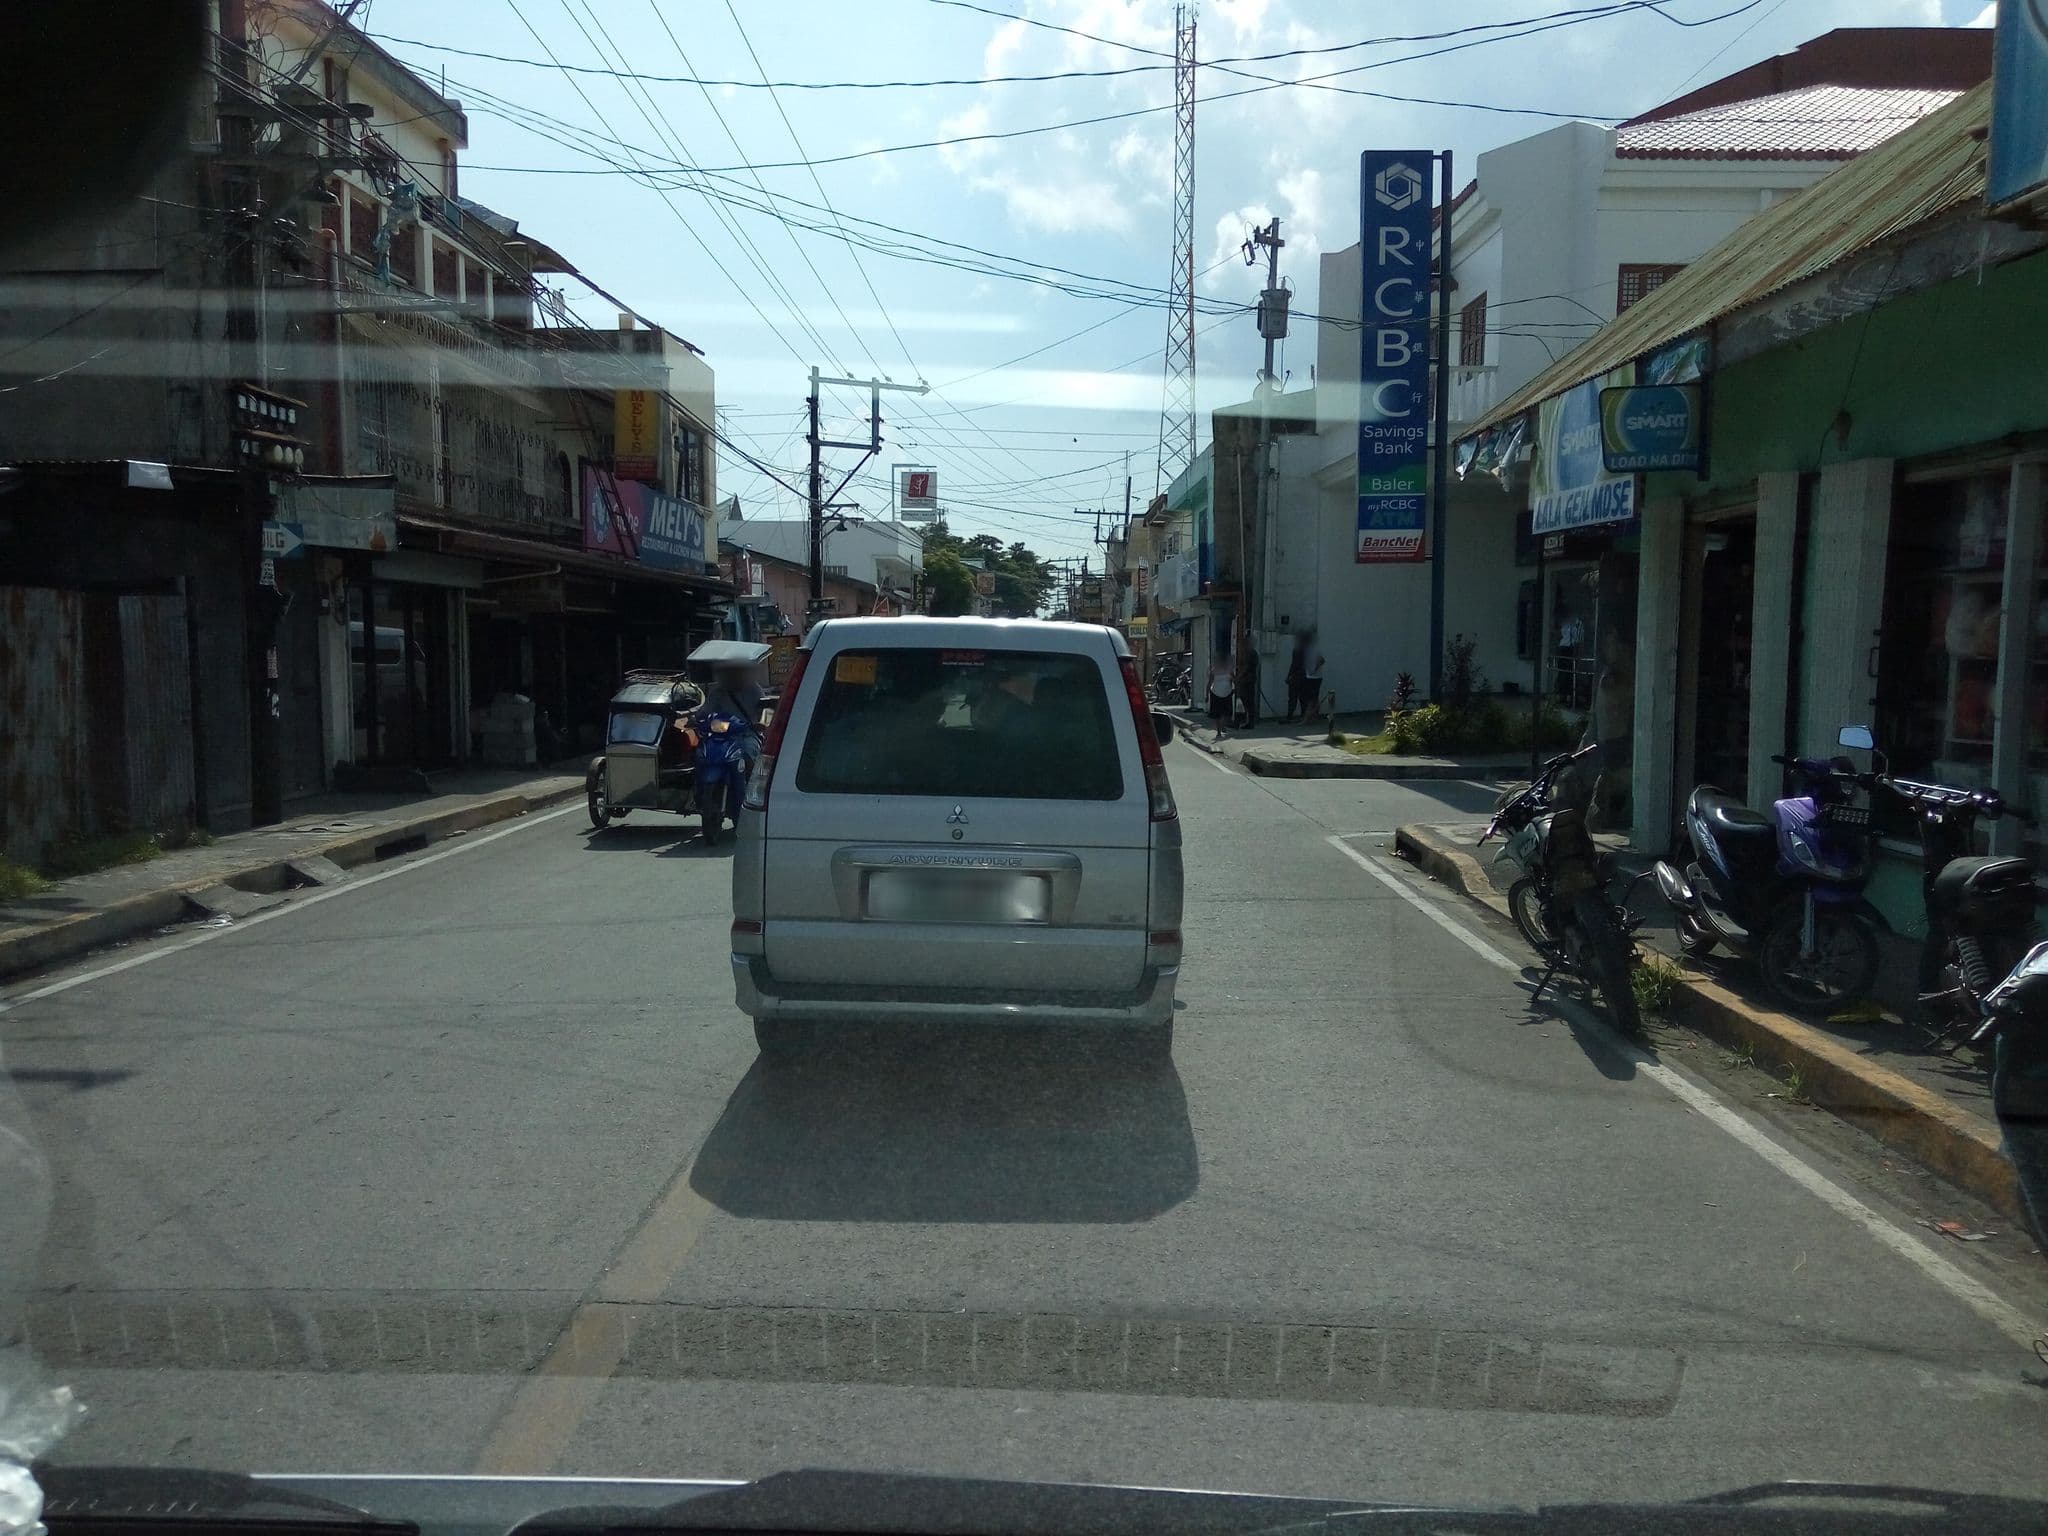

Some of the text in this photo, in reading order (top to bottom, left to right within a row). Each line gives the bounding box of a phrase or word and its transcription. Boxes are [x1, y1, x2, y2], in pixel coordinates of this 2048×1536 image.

[1373, 226, 1415, 418] RCBC
[1626, 412, 1688, 431] SMART
[1364, 425, 1424, 441] Savings
[1374, 442, 1413, 455] Bank
[1611, 455, 1647, 468] LOAD
[1650, 454, 1668, 465] NA
[1372, 478, 1415, 491] Baler
[1367, 499, 1417, 512] myRCBC
[649, 496, 703, 548] MELY'S
[1363, 537, 1418, 548] BancNet
[889, 854, 1023, 867] ADVENTURE
